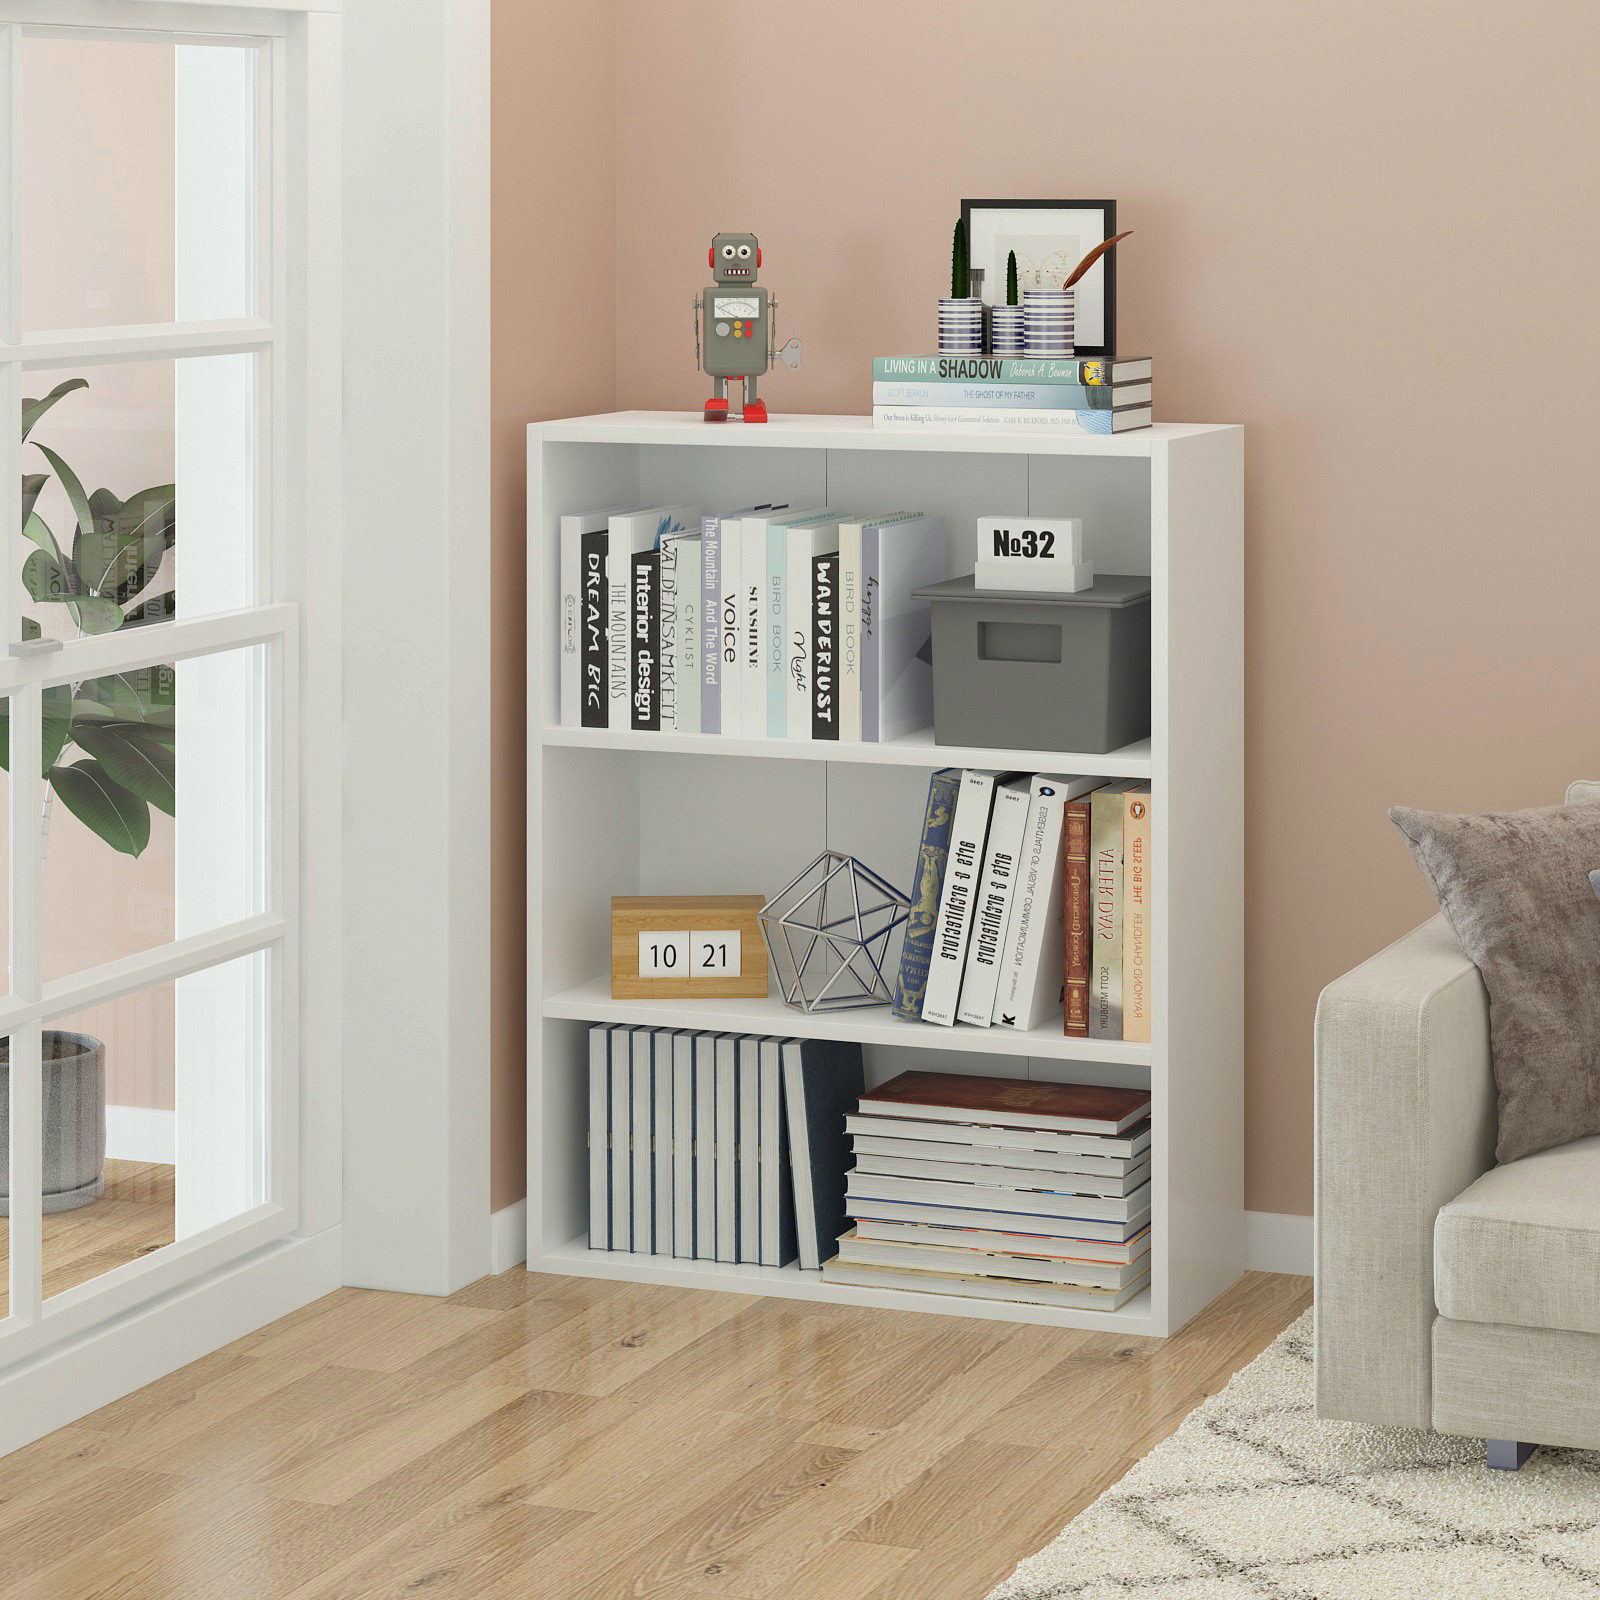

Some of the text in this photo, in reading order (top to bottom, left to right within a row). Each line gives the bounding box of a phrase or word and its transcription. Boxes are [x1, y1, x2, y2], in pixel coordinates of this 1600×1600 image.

[884, 359, 1003, 380] LIVING IN A SHADOW
[964, 390, 1036, 400] THE GHOST OF MY FATHER
[587, 553, 600, 652] DREAM
[611, 583, 627, 700] THE MOUNTAINS
[634, 564, 654, 721] Interior design
[684, 604, 694, 670] CYKLIST
[706, 518, 719, 686] The Mountain And The Word
[724, 594, 740, 664] voice
[748, 586, 758, 670] SUNSHINE
[772, 576, 781, 672] BIRD BOOK
[816, 562, 832, 723] WANDERLUST
[845, 571, 855, 675] BIRD BOOK
[790, 631, 807, 692] Night
[650, 944, 677, 968] 10
[702, 944, 726, 968] 21
